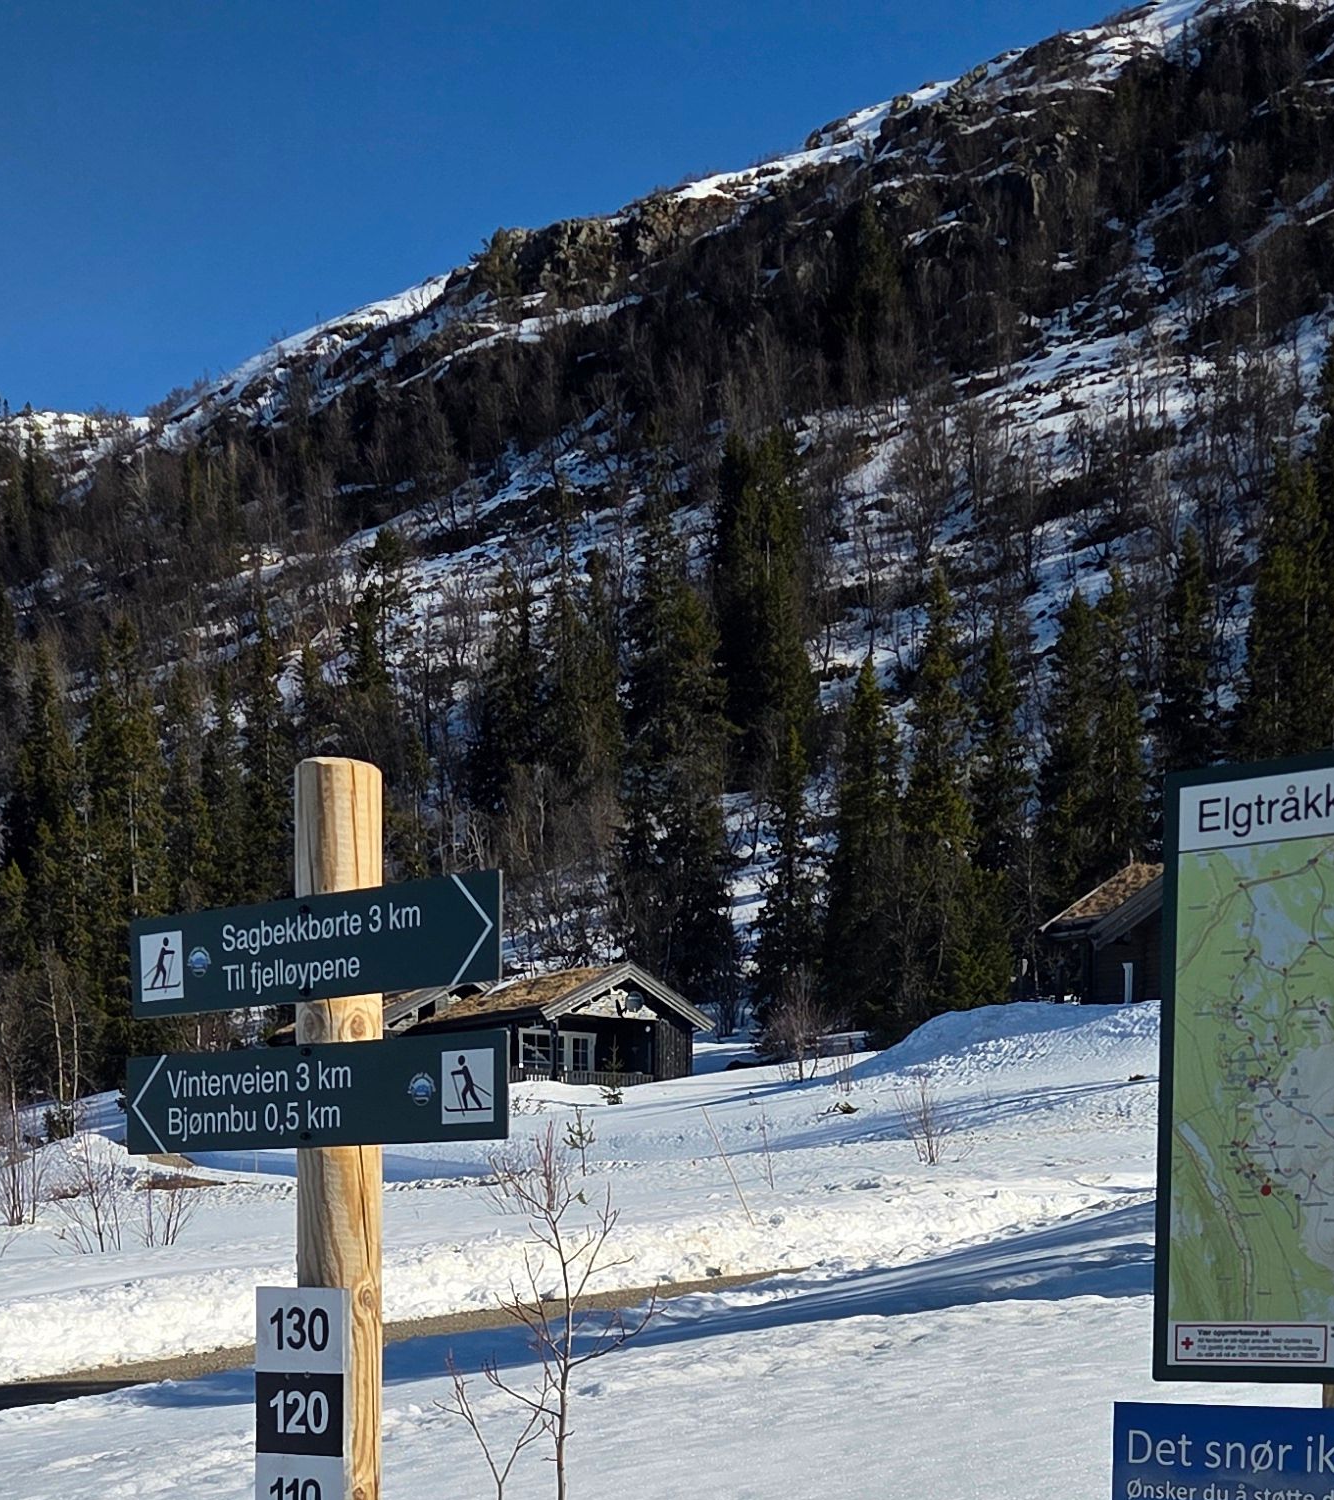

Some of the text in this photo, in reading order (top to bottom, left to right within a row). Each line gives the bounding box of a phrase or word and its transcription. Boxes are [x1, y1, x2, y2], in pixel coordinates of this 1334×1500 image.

[221, 902, 422, 955] Sagbekkbørte 3 km
[221, 962, 245, 991] Til
[250, 956, 361, 995] fjelløypene
[167, 1060, 352, 1099] Vinterveien 3 km
[168, 1099, 341, 1142] Bjønnbu 0,5 km
[269, 1306, 329, 1352] 130
[269, 1389, 329, 1434] 120
[1127, 1429, 1193, 1467] Det
[1204, 1439, 1293, 1474] snør
[1126, 1478, 1198, 1500] Ønsker
